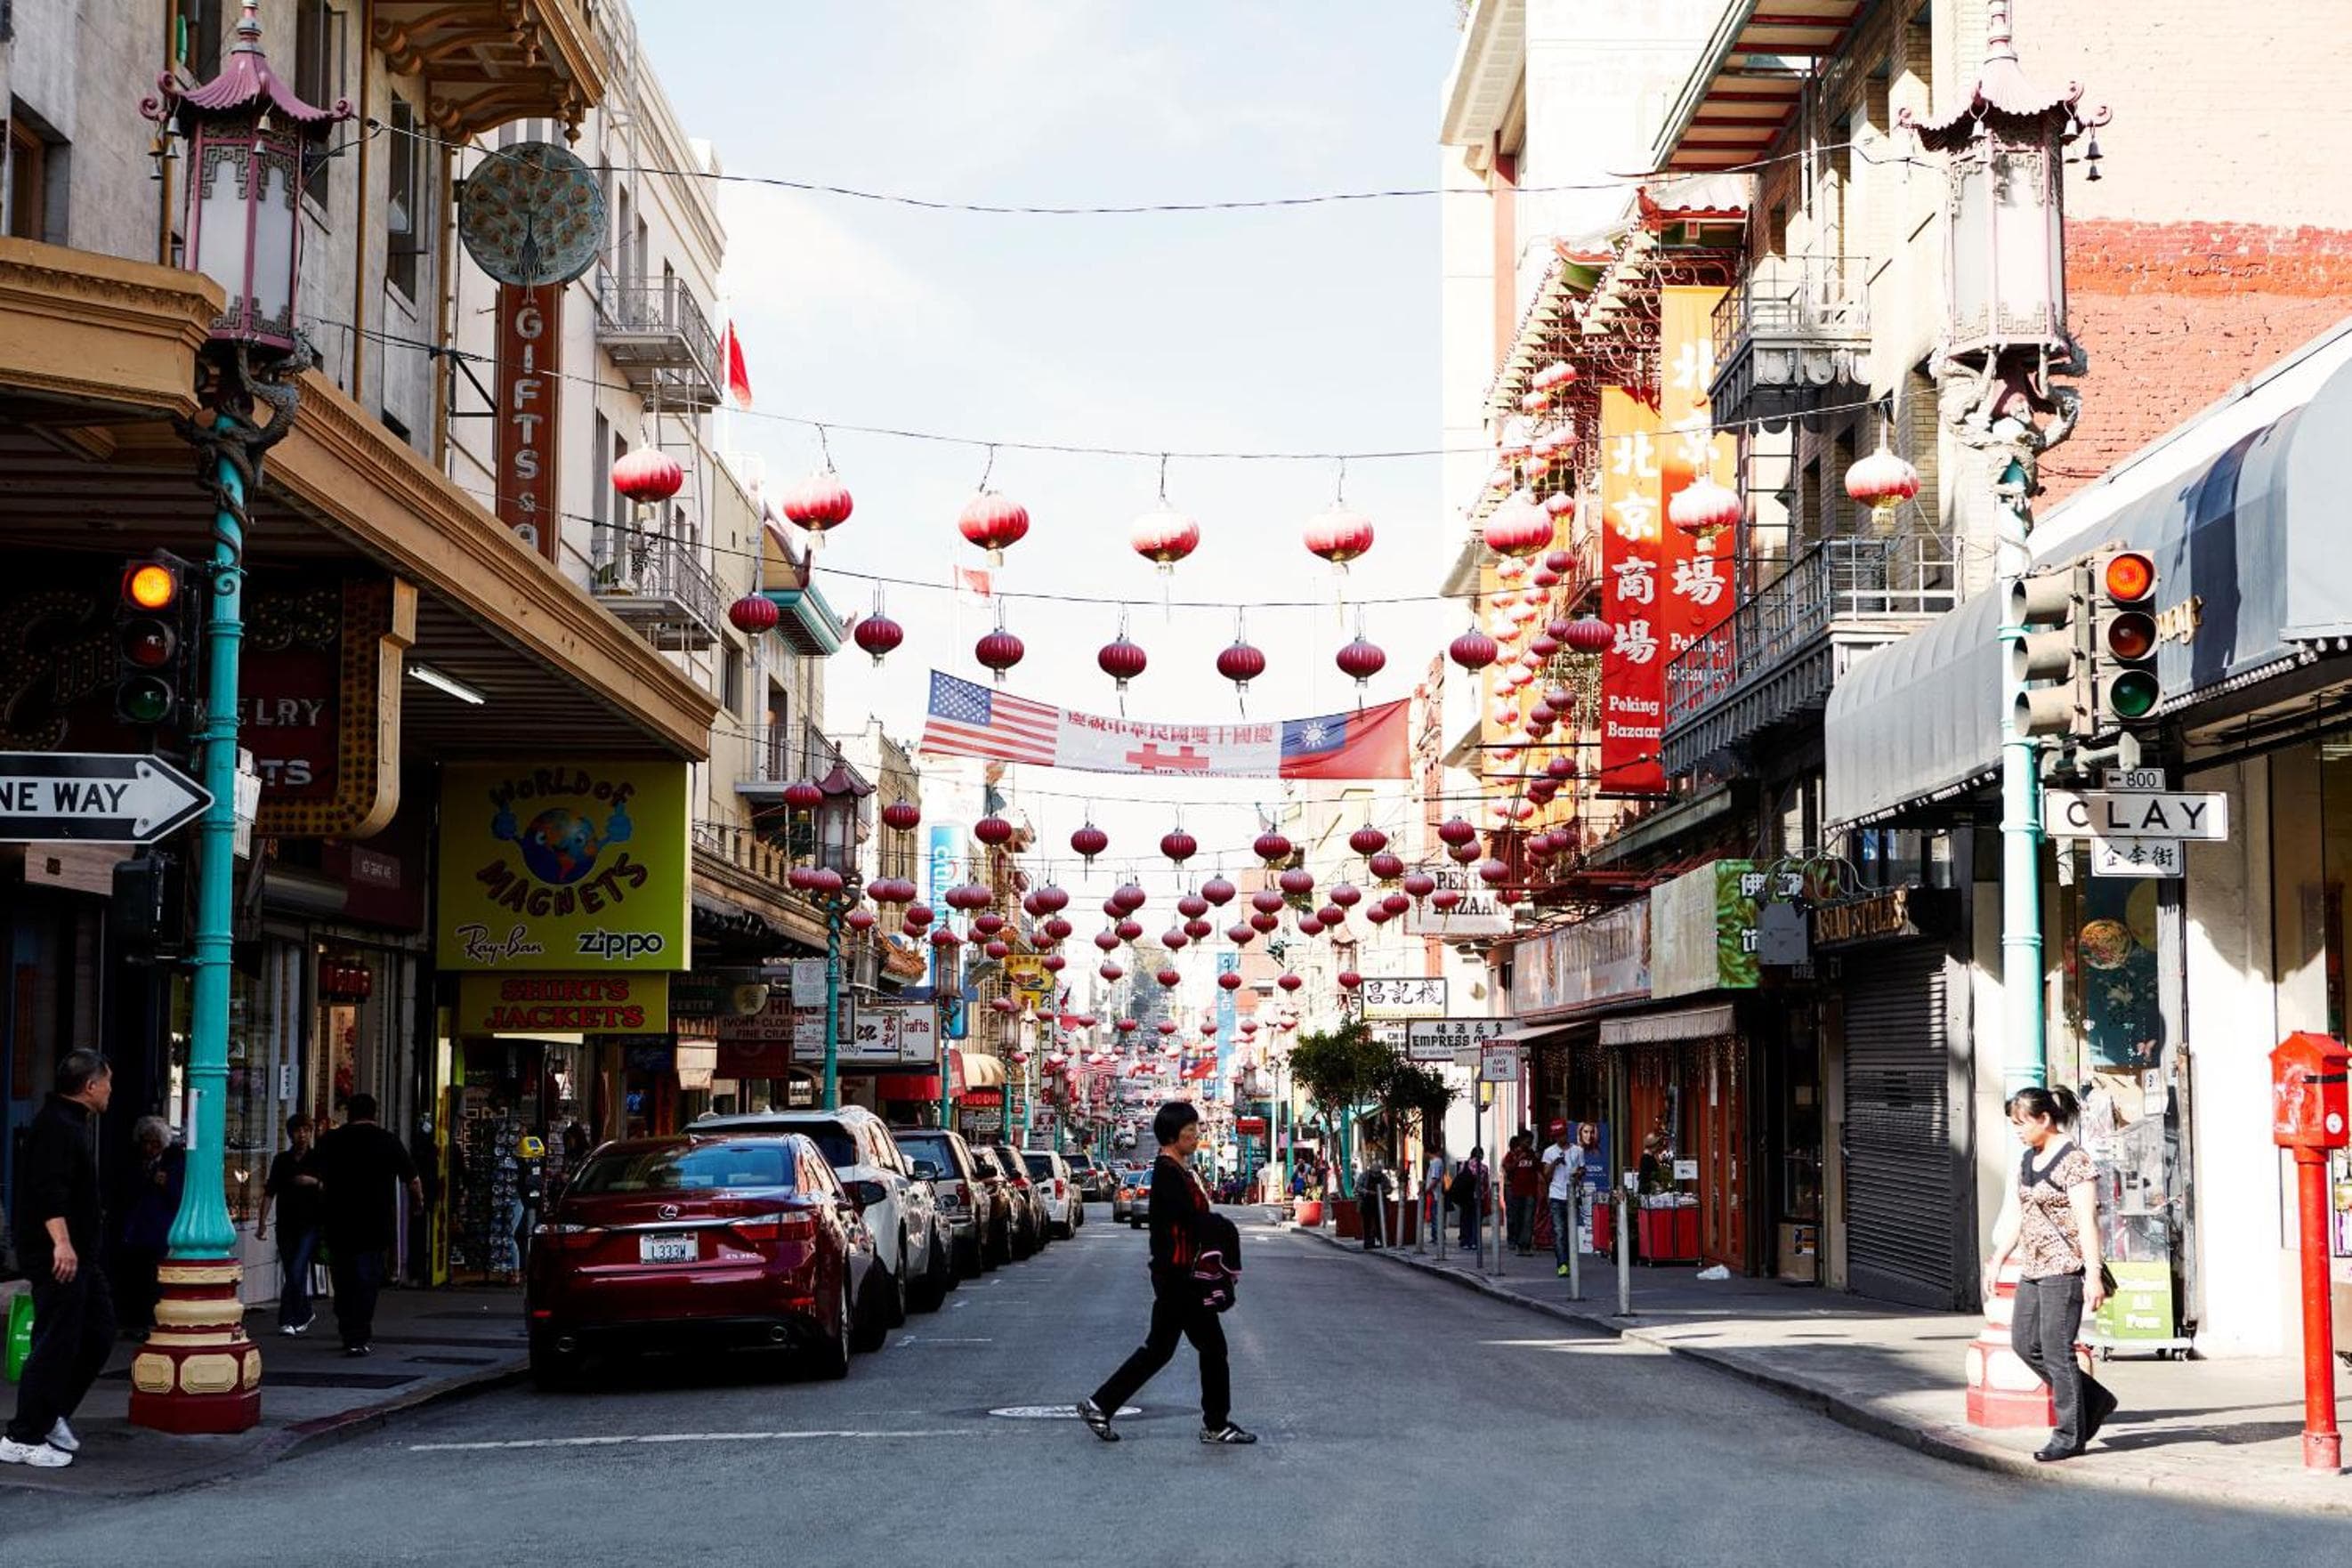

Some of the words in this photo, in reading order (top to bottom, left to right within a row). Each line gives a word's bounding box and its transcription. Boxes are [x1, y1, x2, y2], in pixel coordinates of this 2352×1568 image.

[513, 307, 543, 479] GIFTS
[1671, 338, 1727, 607] 北京場
[1611, 431, 1661, 666] 北京商場
[1608, 695, 1660, 715] Peking
[1607, 723, 1661, 739] Bazaar
[2126, 772, 2157, 788] 800
[0, 782, 35, 812] NE
[53, 783, 129, 812] WAY
[2066, 799, 2207, 830] CLAY
[477, 852, 648, 917] MAGNETS
[457, 925, 544, 964] Ray-Ban
[578, 929, 663, 958] zippo
[501, 979, 630, 1002] SHIRTS
[484, 1006, 645, 1030] JACKETS
[902, 1019, 930, 1033] rafts
[1411, 1035, 1470, 1047] EMPRESS
